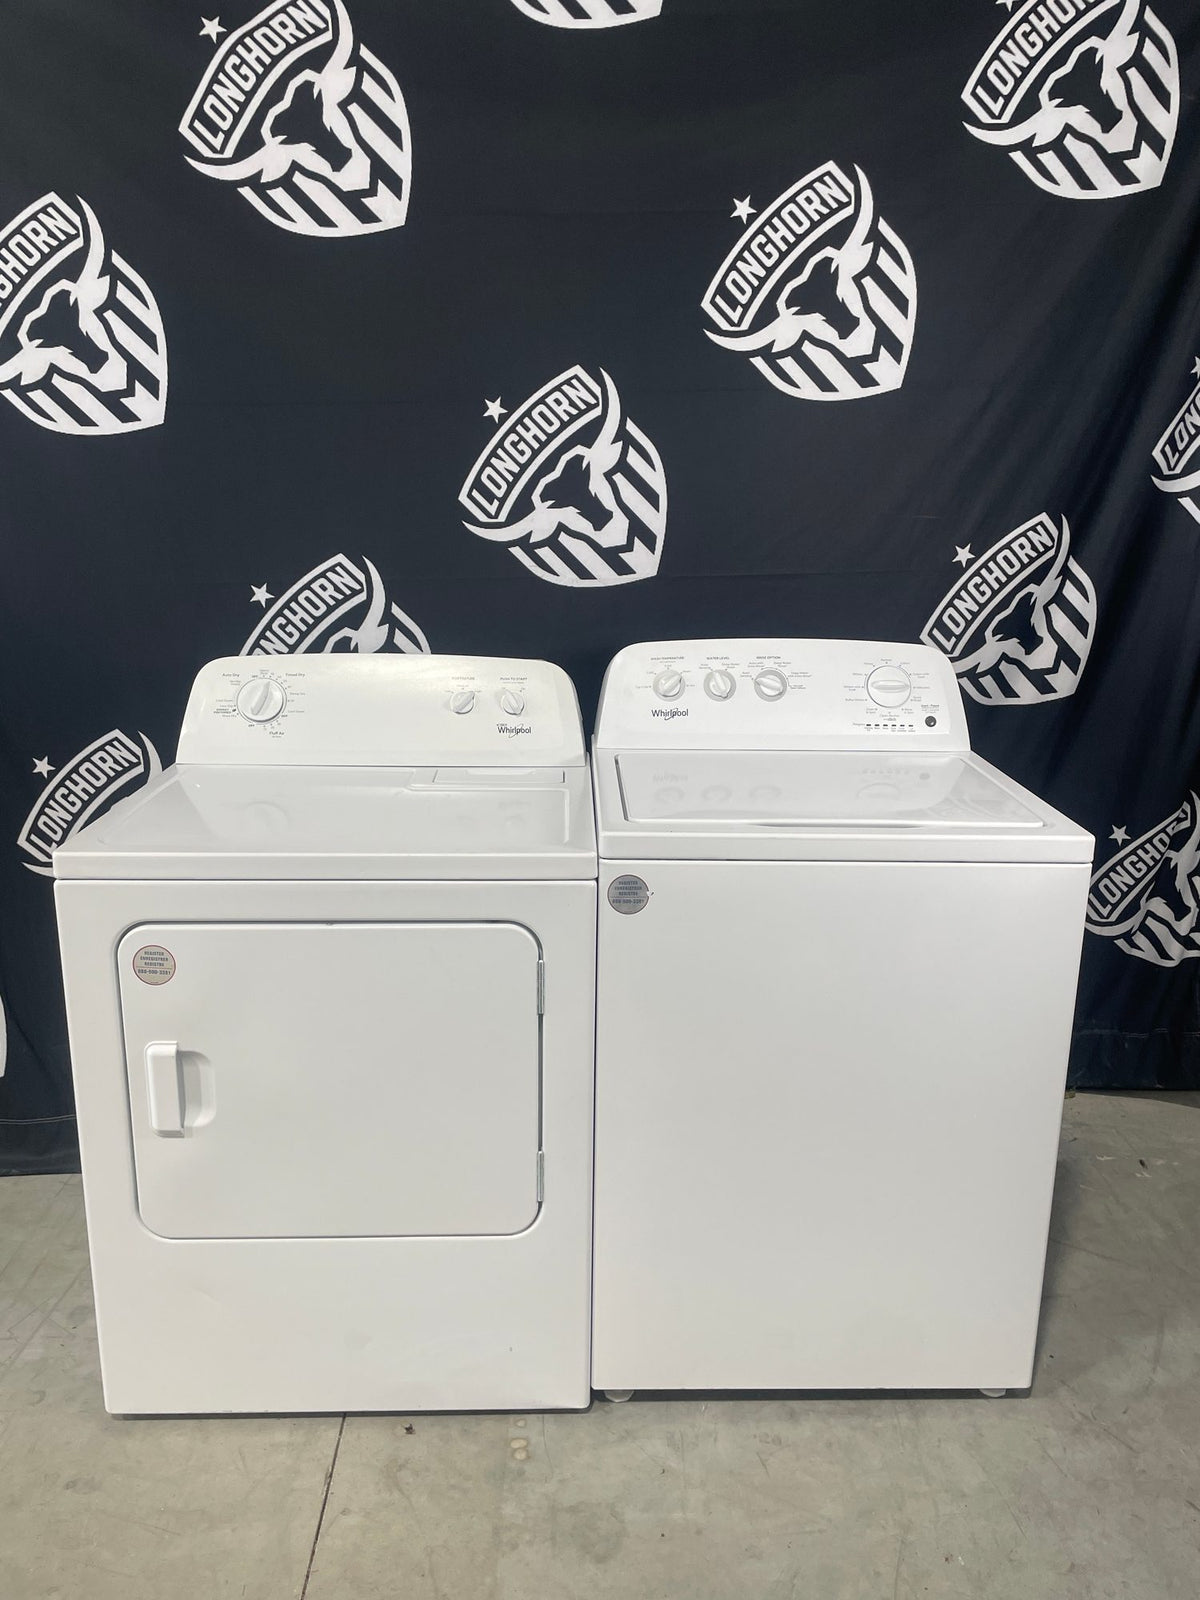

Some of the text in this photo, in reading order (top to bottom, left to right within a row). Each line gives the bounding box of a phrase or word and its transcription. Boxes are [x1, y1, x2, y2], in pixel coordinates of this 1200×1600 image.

[193, 0, 327, 151] LONGHORN
[975, 0, 1096, 117] LONGHO
[714, 175, 850, 324] LONGHORN
[471, 378, 597, 516] LONGHORN
[1164, 391, 1200, 469] LON
[252, 565, 362, 655] NGHORN
[932, 524, 1053, 651] LONGHORN
[497, 725, 532, 737] Whirlpool
[651, 708, 689, 719] Whirlpool
[29, 740, 139, 856] LONGHORN
